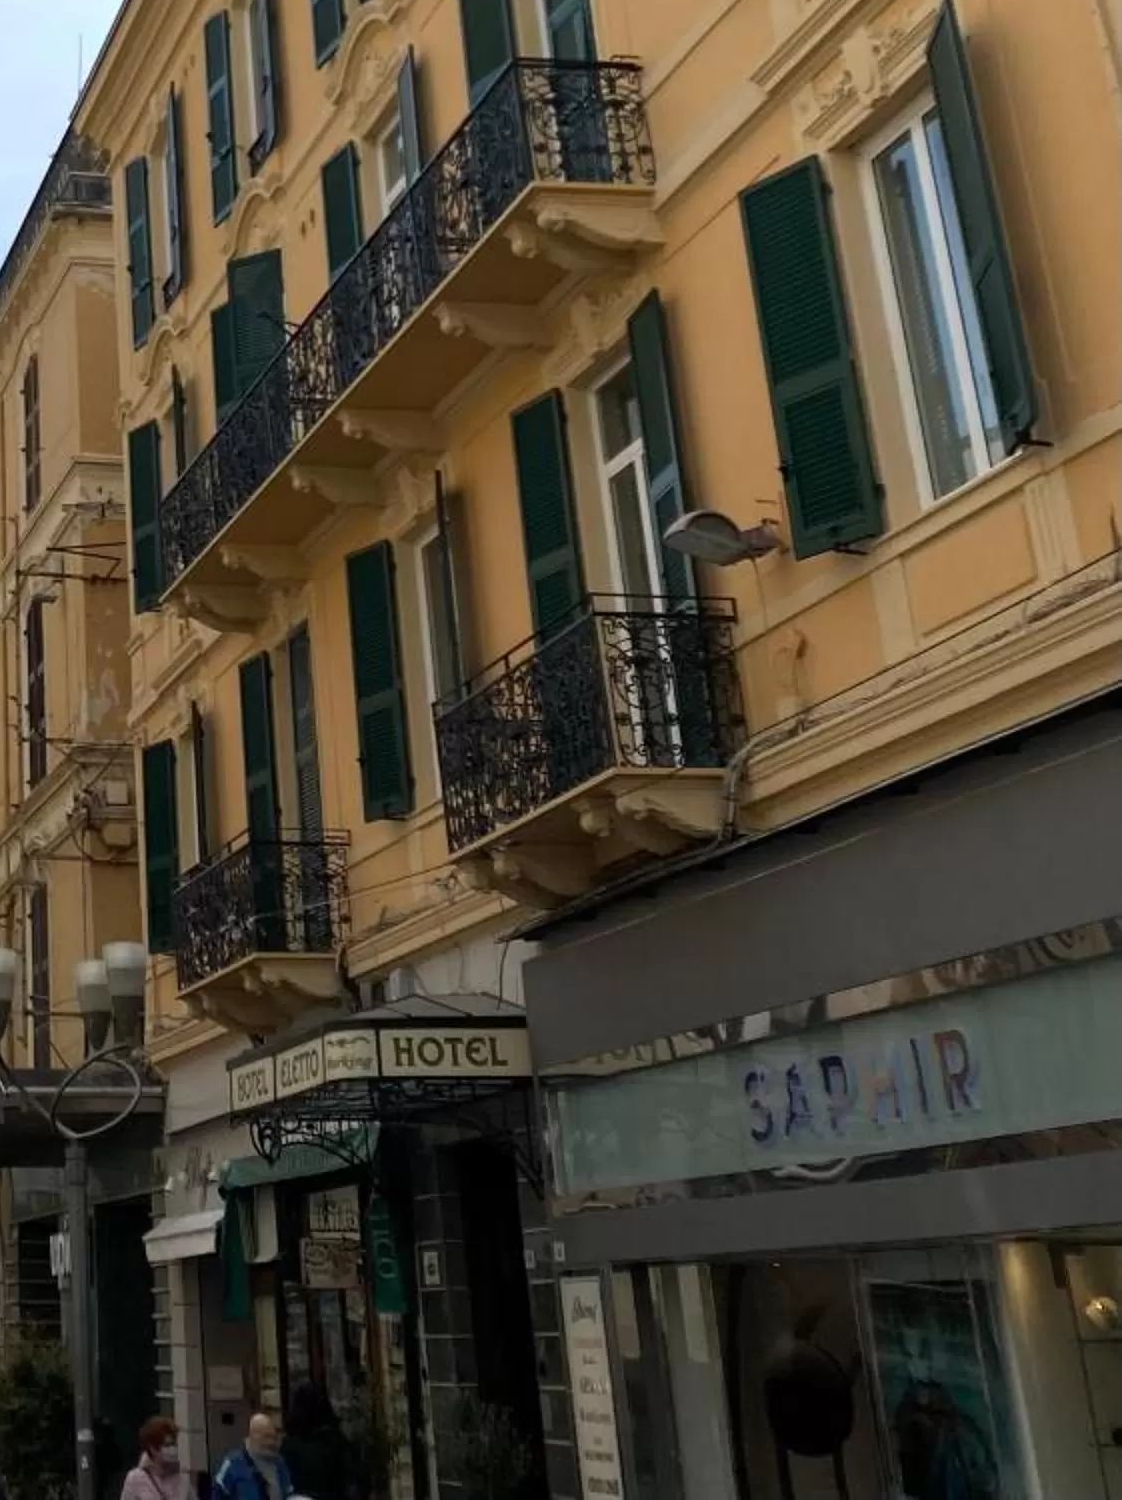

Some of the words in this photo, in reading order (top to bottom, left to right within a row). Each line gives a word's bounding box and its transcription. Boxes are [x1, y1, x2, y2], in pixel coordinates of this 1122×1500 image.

[236, 1068, 270, 1103] HOTEL
[280, 1048, 320, 1089] ELETTO
[391, 1036, 509, 1068] HOTEL
[744, 1028, 979, 1143] SAPHIR
